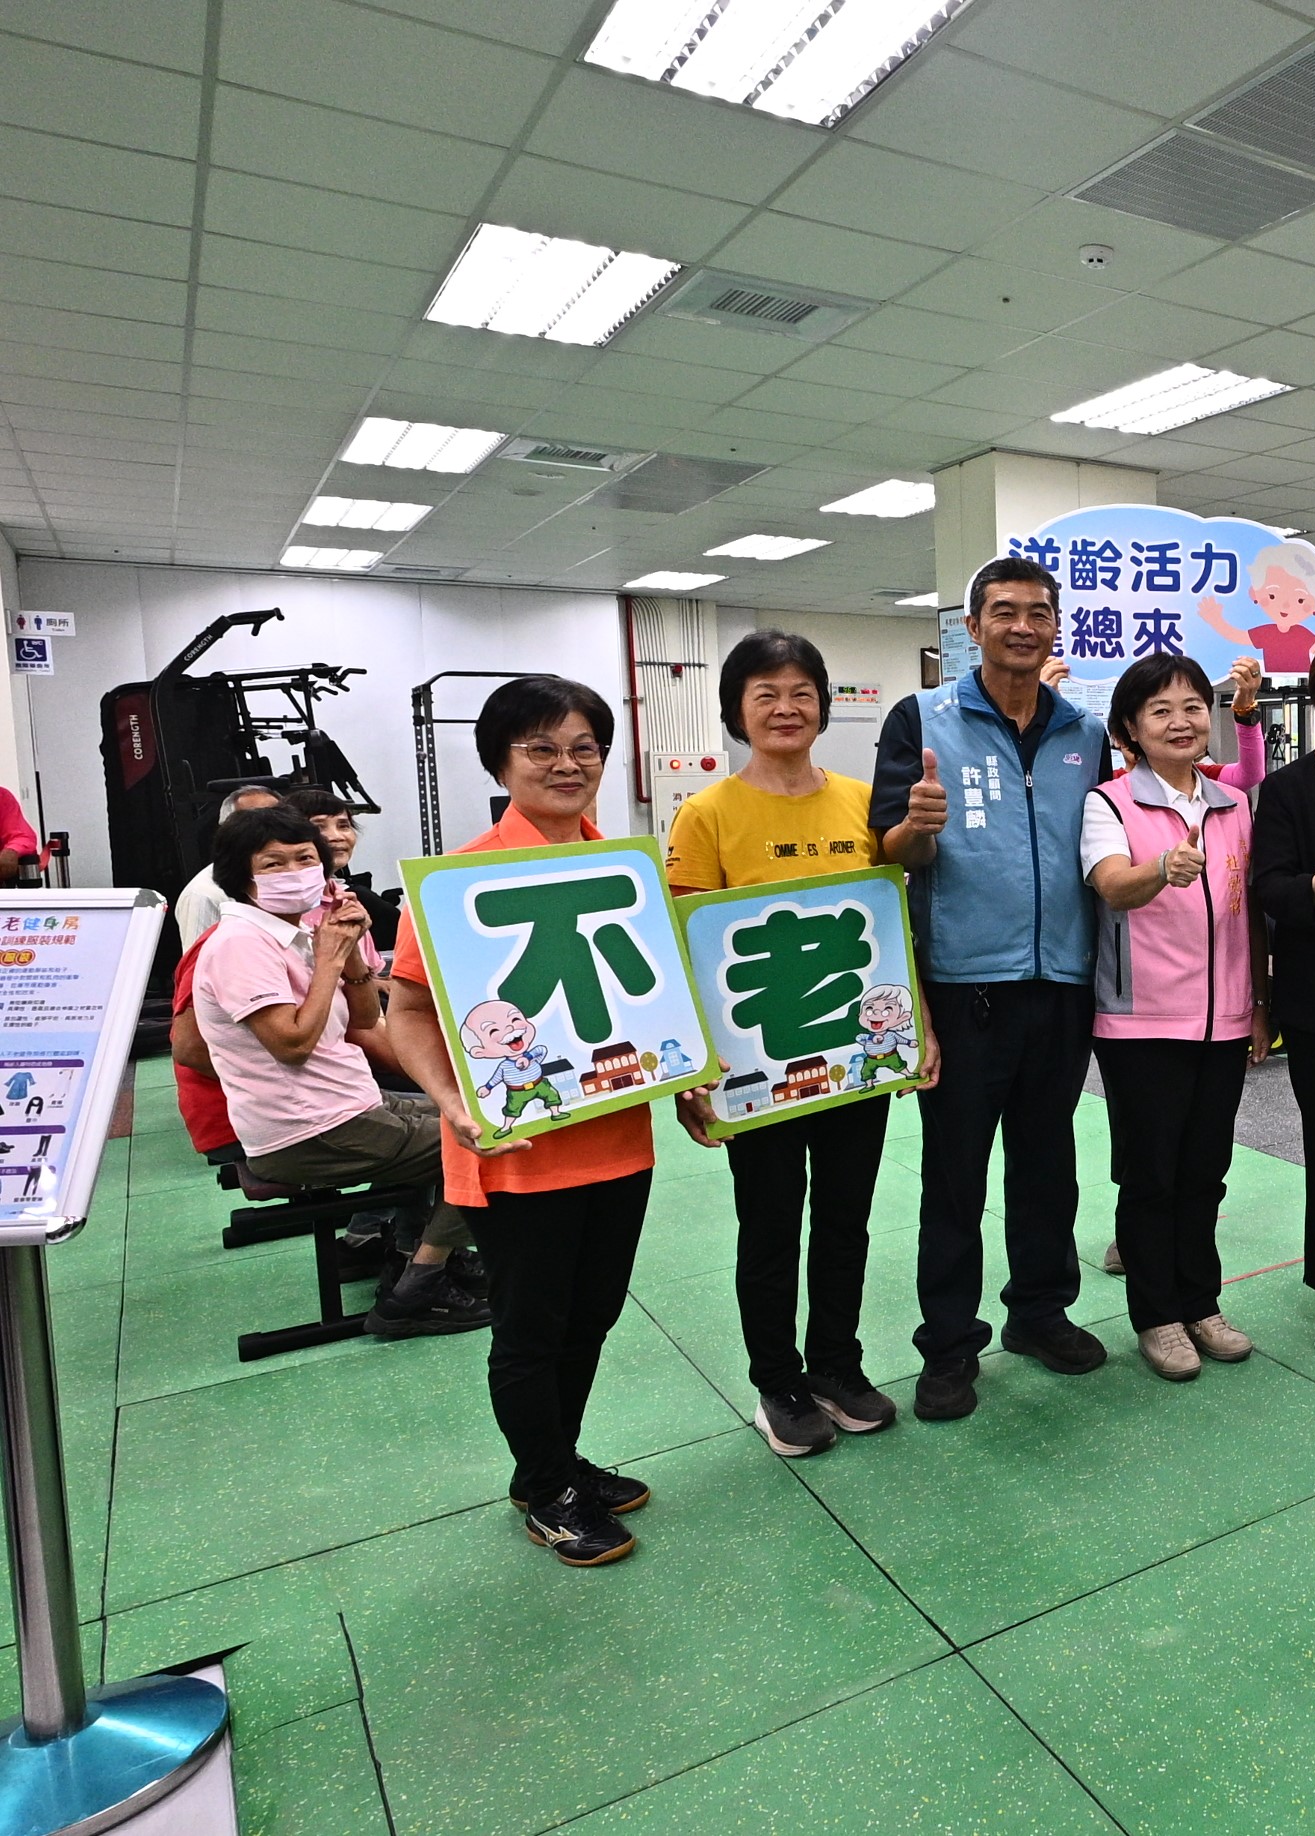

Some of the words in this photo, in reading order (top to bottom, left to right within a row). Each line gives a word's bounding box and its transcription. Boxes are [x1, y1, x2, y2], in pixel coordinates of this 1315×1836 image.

[183, 634, 213, 661] CORENGTH
[1051, 606, 1183, 658] 總來
[129, 714, 144, 760] CORENGTH
[0, 915, 80, 932] 老健身房
[474, 874, 657, 1044] 不
[725, 907, 872, 1061] 老
